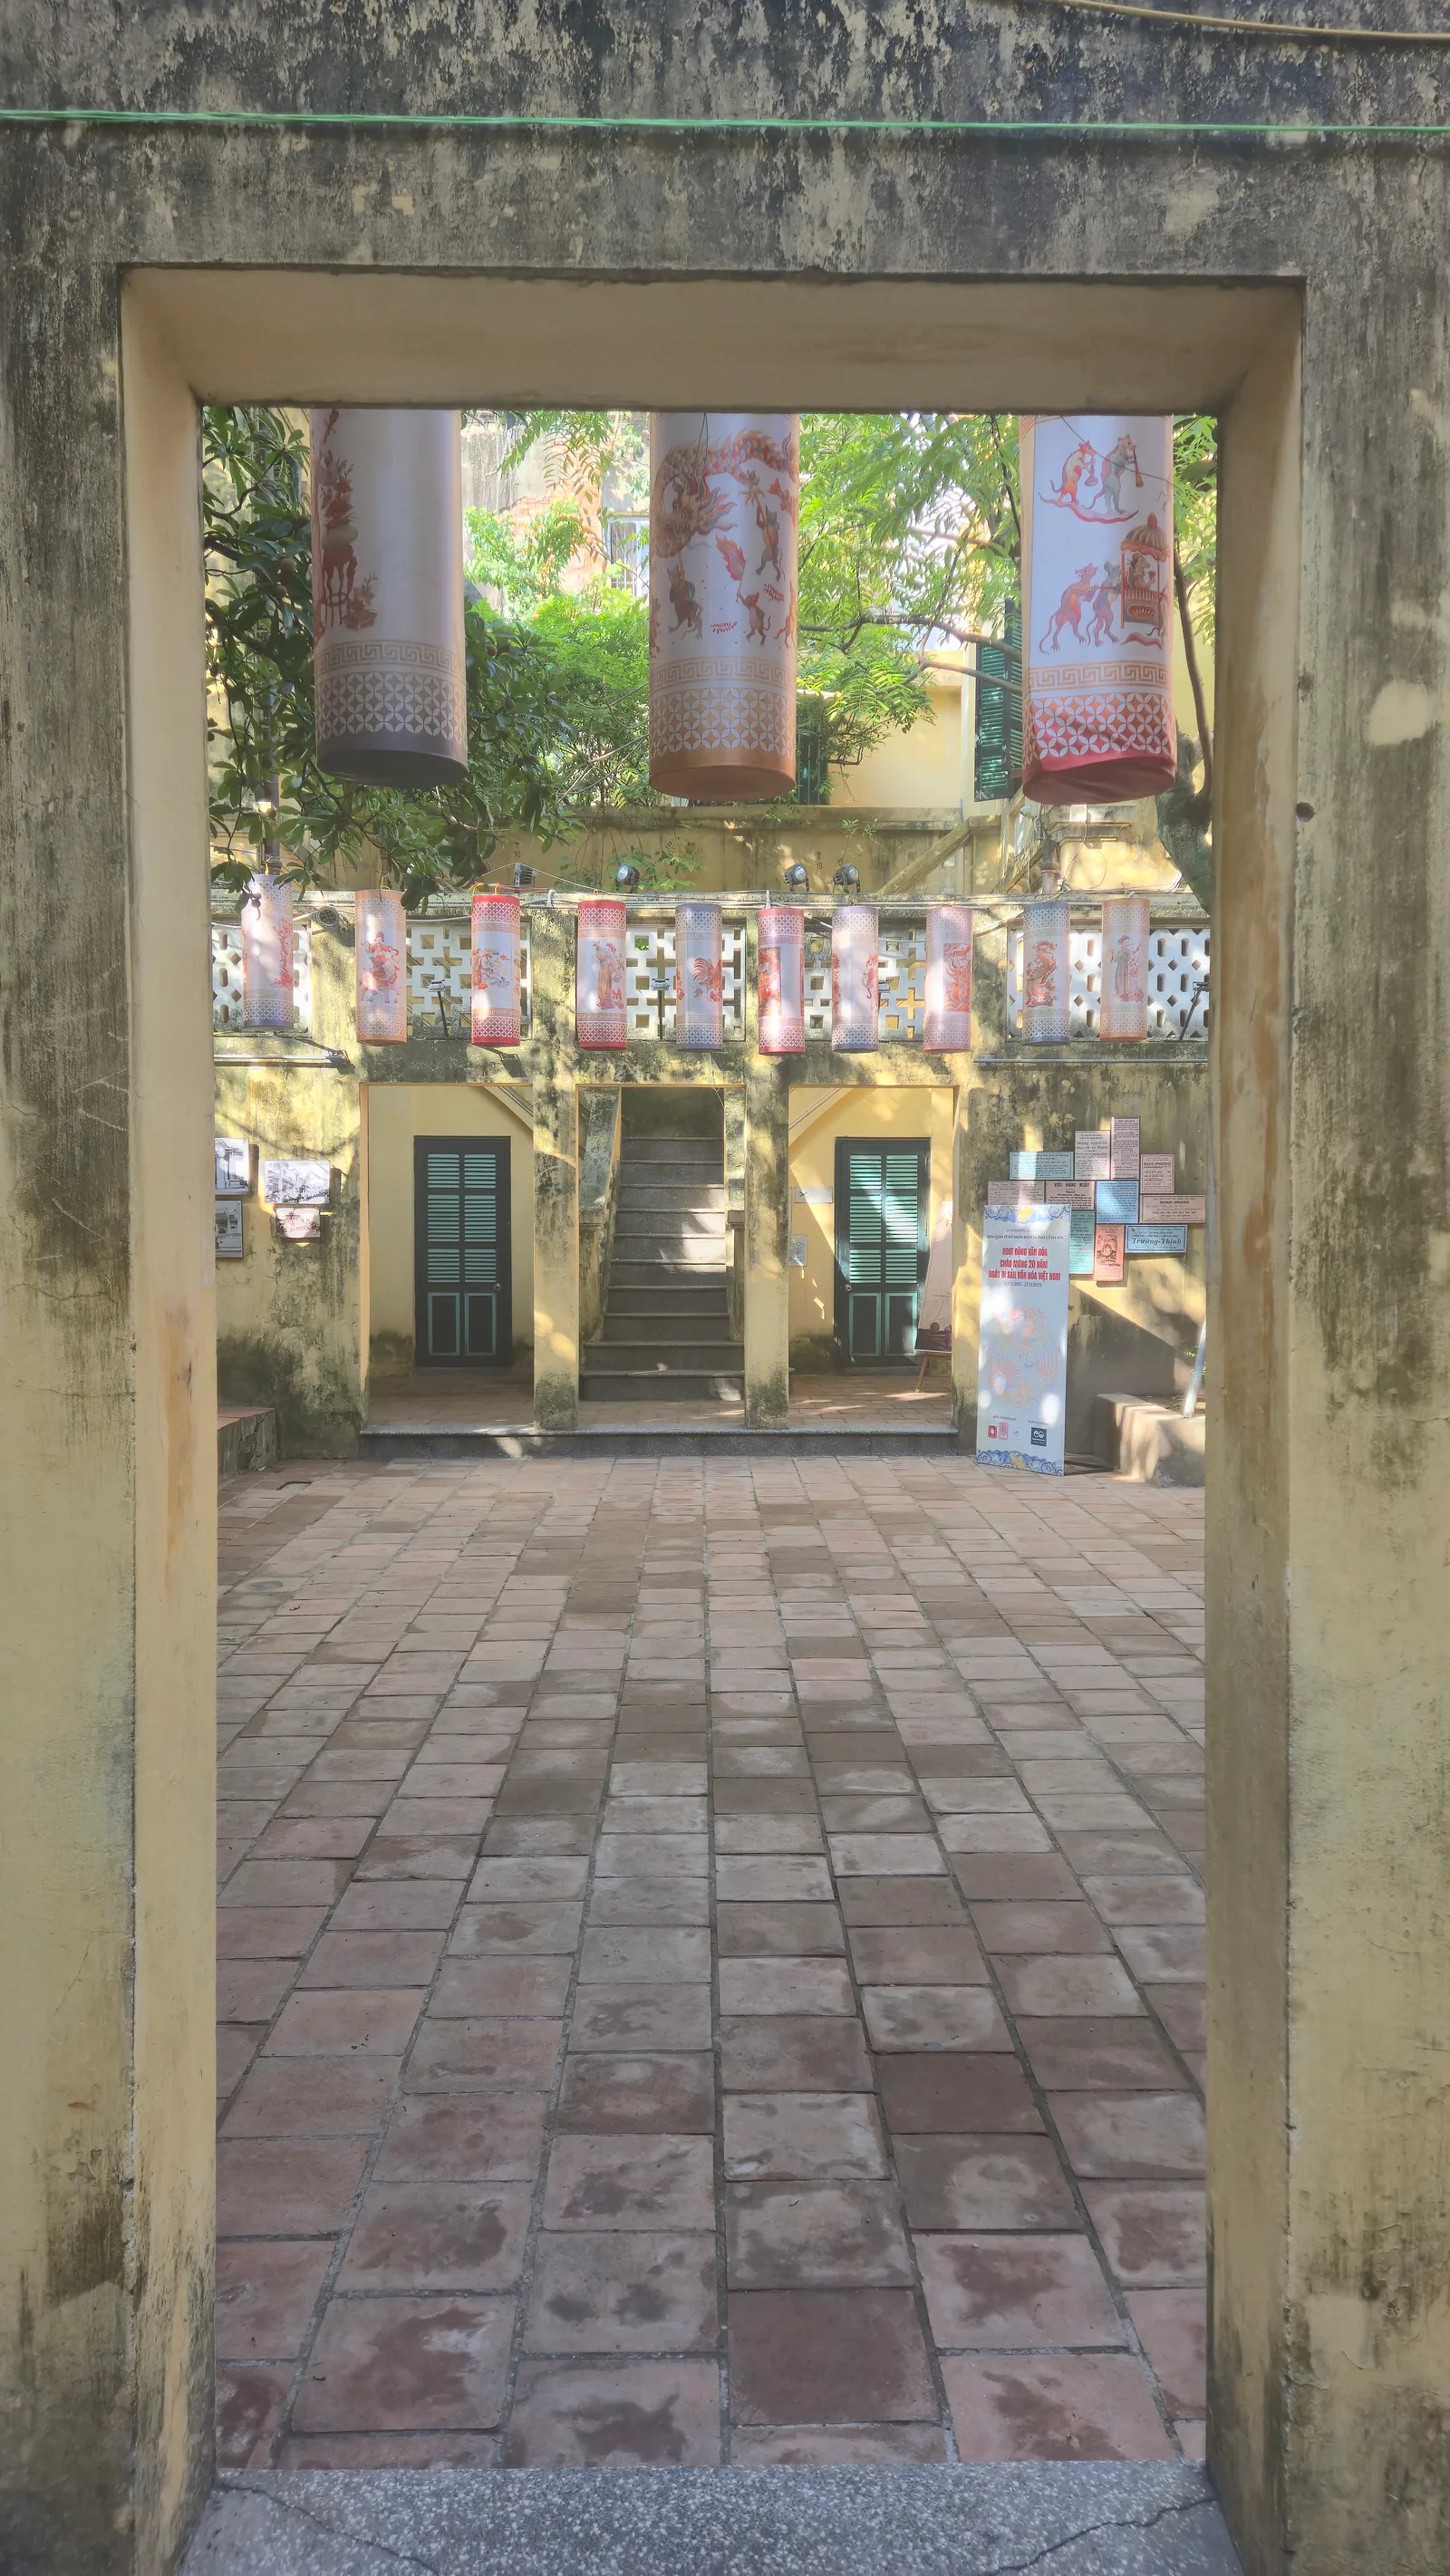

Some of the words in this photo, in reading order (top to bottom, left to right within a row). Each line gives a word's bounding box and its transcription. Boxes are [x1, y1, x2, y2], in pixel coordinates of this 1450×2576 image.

[1002, 1248, 1014, 1258] HOẠT
[1014, 1246, 1028, 1258] ĐỘNG
[1028, 1246, 1038, 1257] VĂN
[1000, 1258, 1012, 1269] CHÀO
[1012, 1259, 1028, 1269] MỪNG
[1029, 1259, 1036, 1269] 20
[1036, 1259, 1049, 1269] NĂM
[988, 1269, 1000, 1278] NGÀY
[1000, 1270, 1007, 1279] DI
[1007, 1269, 1017, 1279] SẢN
[1017, 1269, 1027, 1280] VĂN
[1038, 1270, 1049, 1282] VIỆT
[1049, 1272, 1061, 1281] NAM
